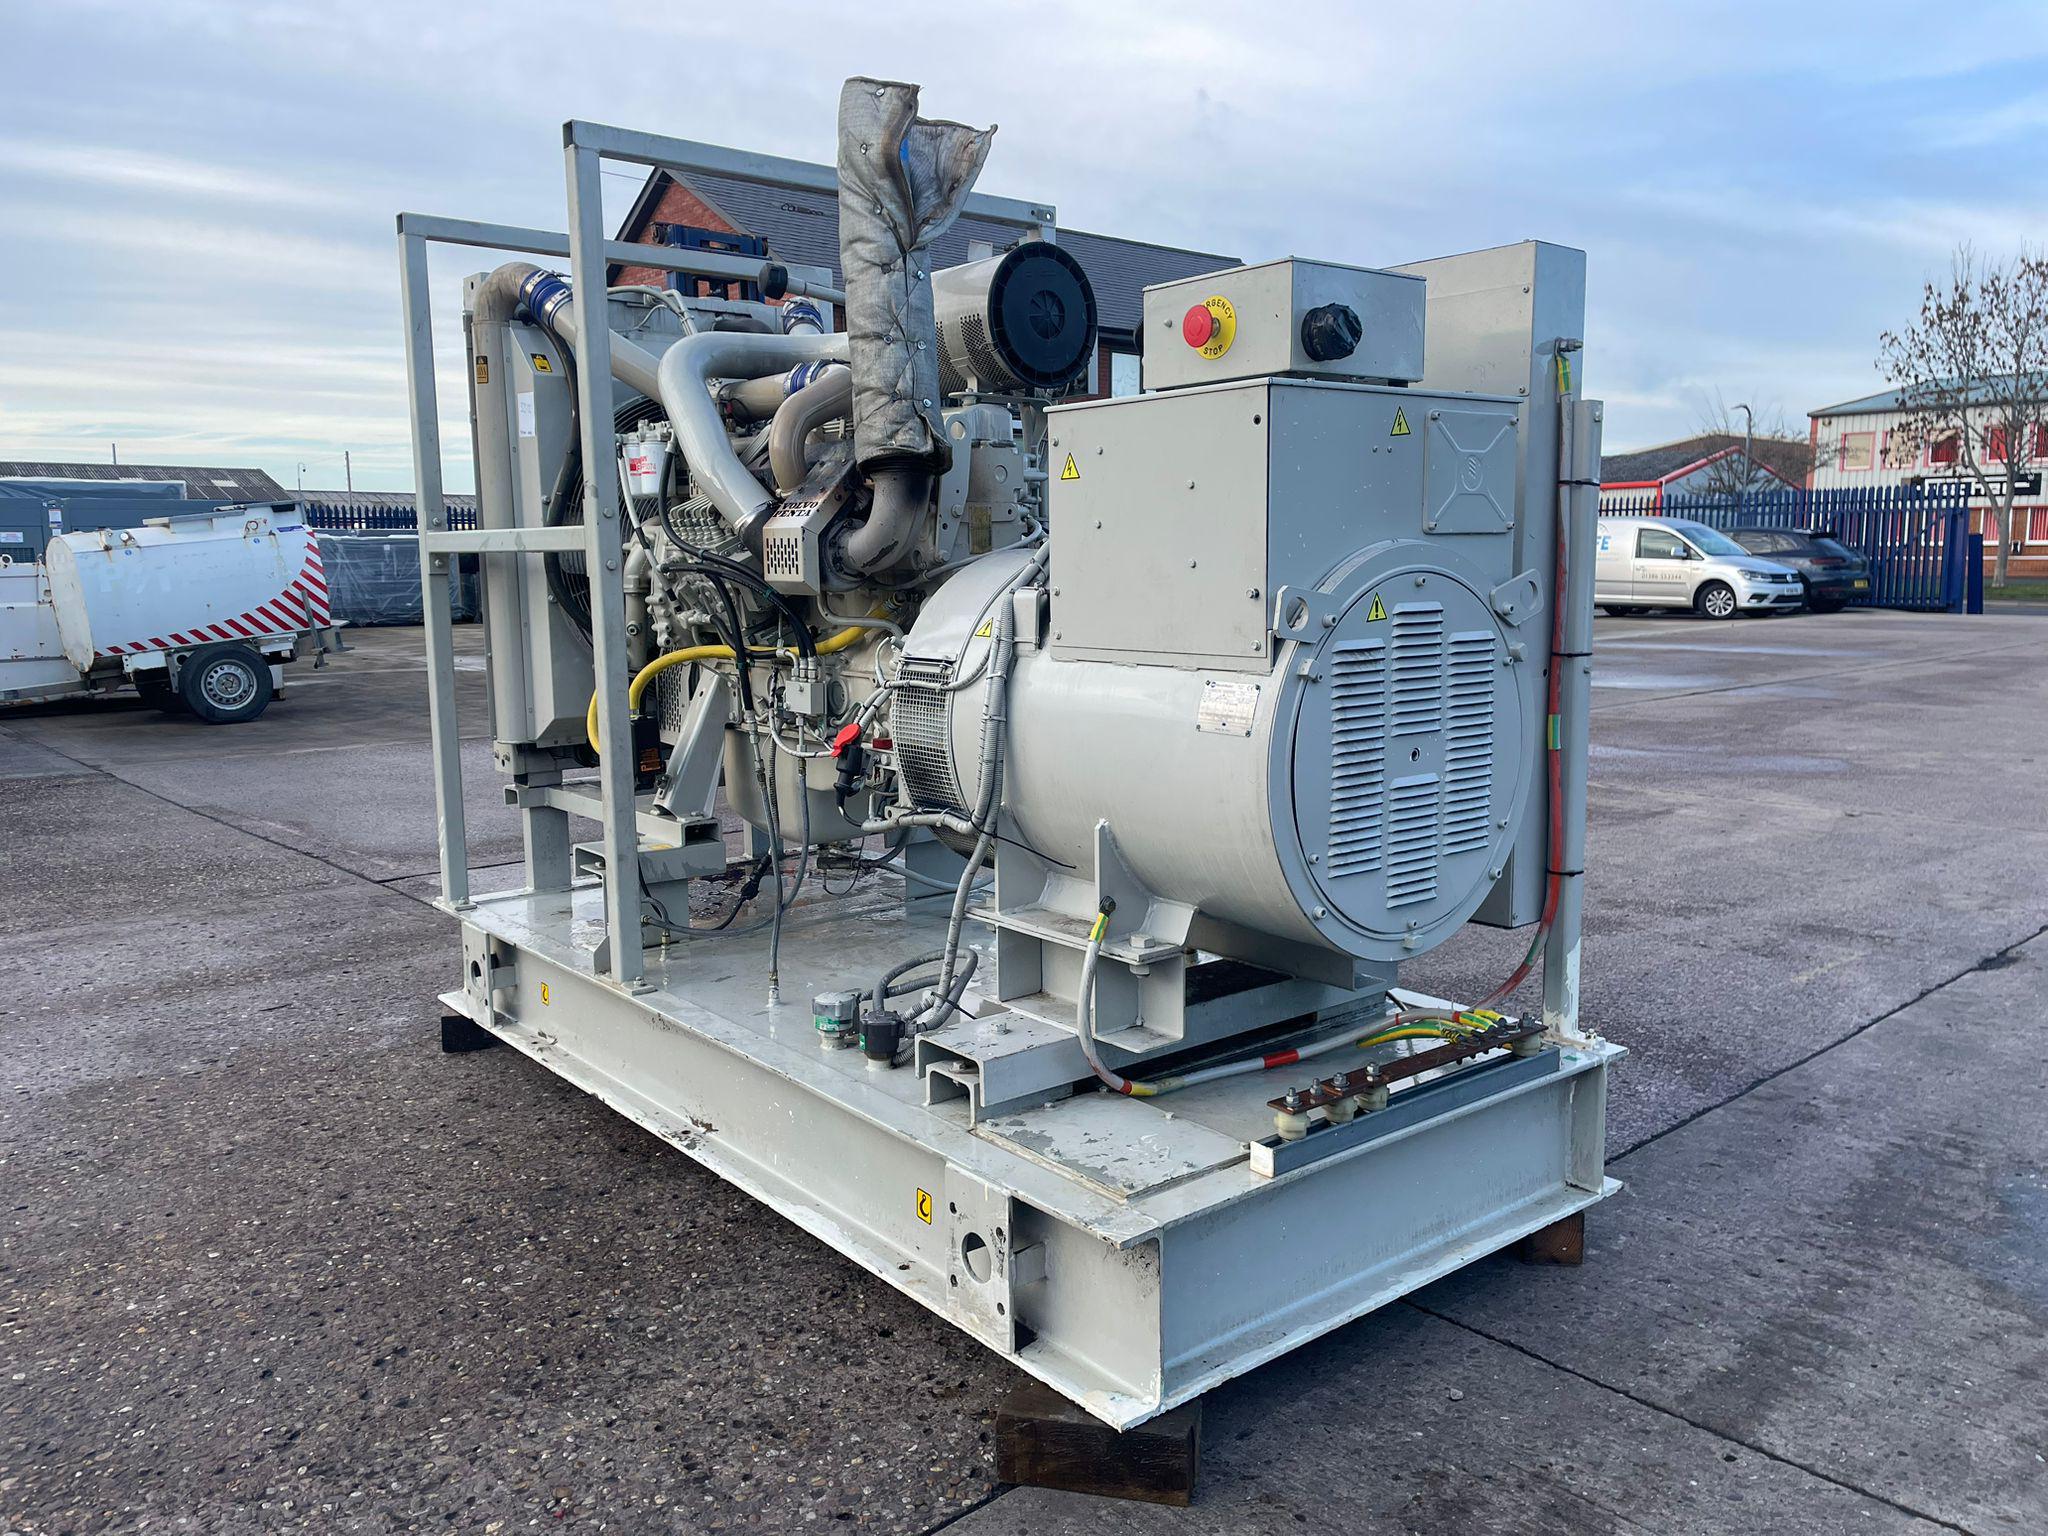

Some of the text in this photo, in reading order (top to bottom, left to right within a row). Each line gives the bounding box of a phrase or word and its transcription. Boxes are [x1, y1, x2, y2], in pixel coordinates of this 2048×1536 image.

[1205, 299, 1232, 319] RGENCY
[1203, 344, 1223, 355] STOP
[782, 501, 818, 509] VOLVO
